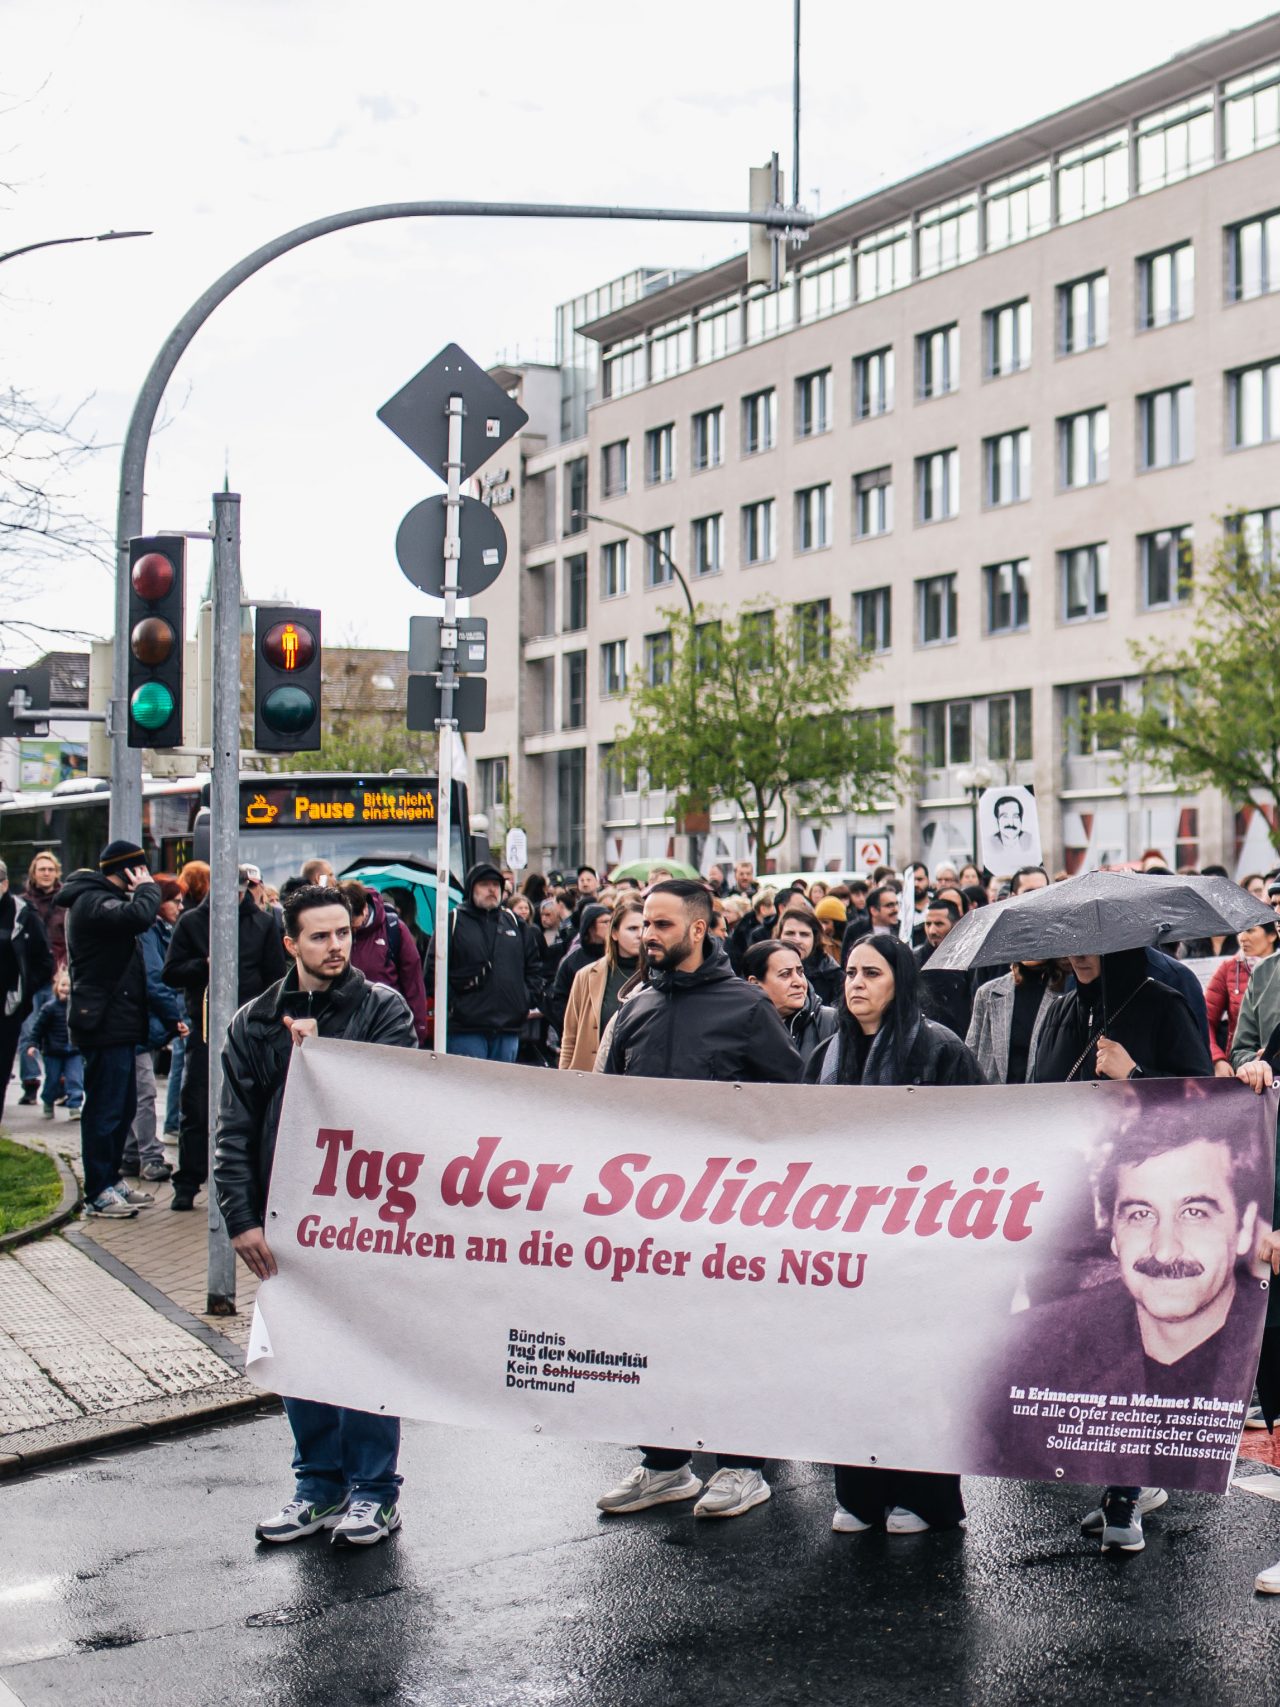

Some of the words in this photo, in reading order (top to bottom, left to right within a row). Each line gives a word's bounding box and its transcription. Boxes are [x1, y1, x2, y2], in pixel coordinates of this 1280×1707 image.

[296, 796, 355, 820] Pause
[363, 792, 396, 807] Bitte
[398, 791, 432, 807] nicht
[362, 806, 435, 820] einsteigen!
[312, 1128, 425, 1223] Tag
[440, 1136, 574, 1212] der
[583, 1153, 1045, 1243] Solidarität
[296, 1215, 455, 1259] Gedenken
[465, 1235, 508, 1263] an
[518, 1230, 573, 1268] die
[584, 1235, 691, 1282] Opfer
[701, 1243, 766, 1282] des
[777, 1248, 868, 1289] NSU
[509, 1328, 566, 1346] Bündnis
[507, 1343, 537, 1361] Tag
[538, 1346, 565, 1361] der
[567, 1348, 648, 1369] Solidarität
[506, 1360, 538, 1375] Kein
[542, 1363, 641, 1385] Schlussstrich
[506, 1375, 575, 1393] Dortmund
[1009, 1385, 1025, 1400] In
[1028, 1387, 1107, 1407] Erinnerung
[1109, 1394, 1127, 1407] an
[1129, 1393, 1190, 1409] Mehmet
[1012, 1403, 1038, 1417] und
[1041, 1405, 1066, 1418] alle
[1069, 1405, 1108, 1422] Opfer
[1111, 1409, 1163, 1426] rechter,
[1165, 1412, 1243, 1430] rassistischer
[1057, 1421, 1084, 1435] und
[1086, 1424, 1194, 1442] antisemitischer
[1047, 1435, 1116, 1453] Solidarität
[1119, 1440, 1151, 1456] statt
